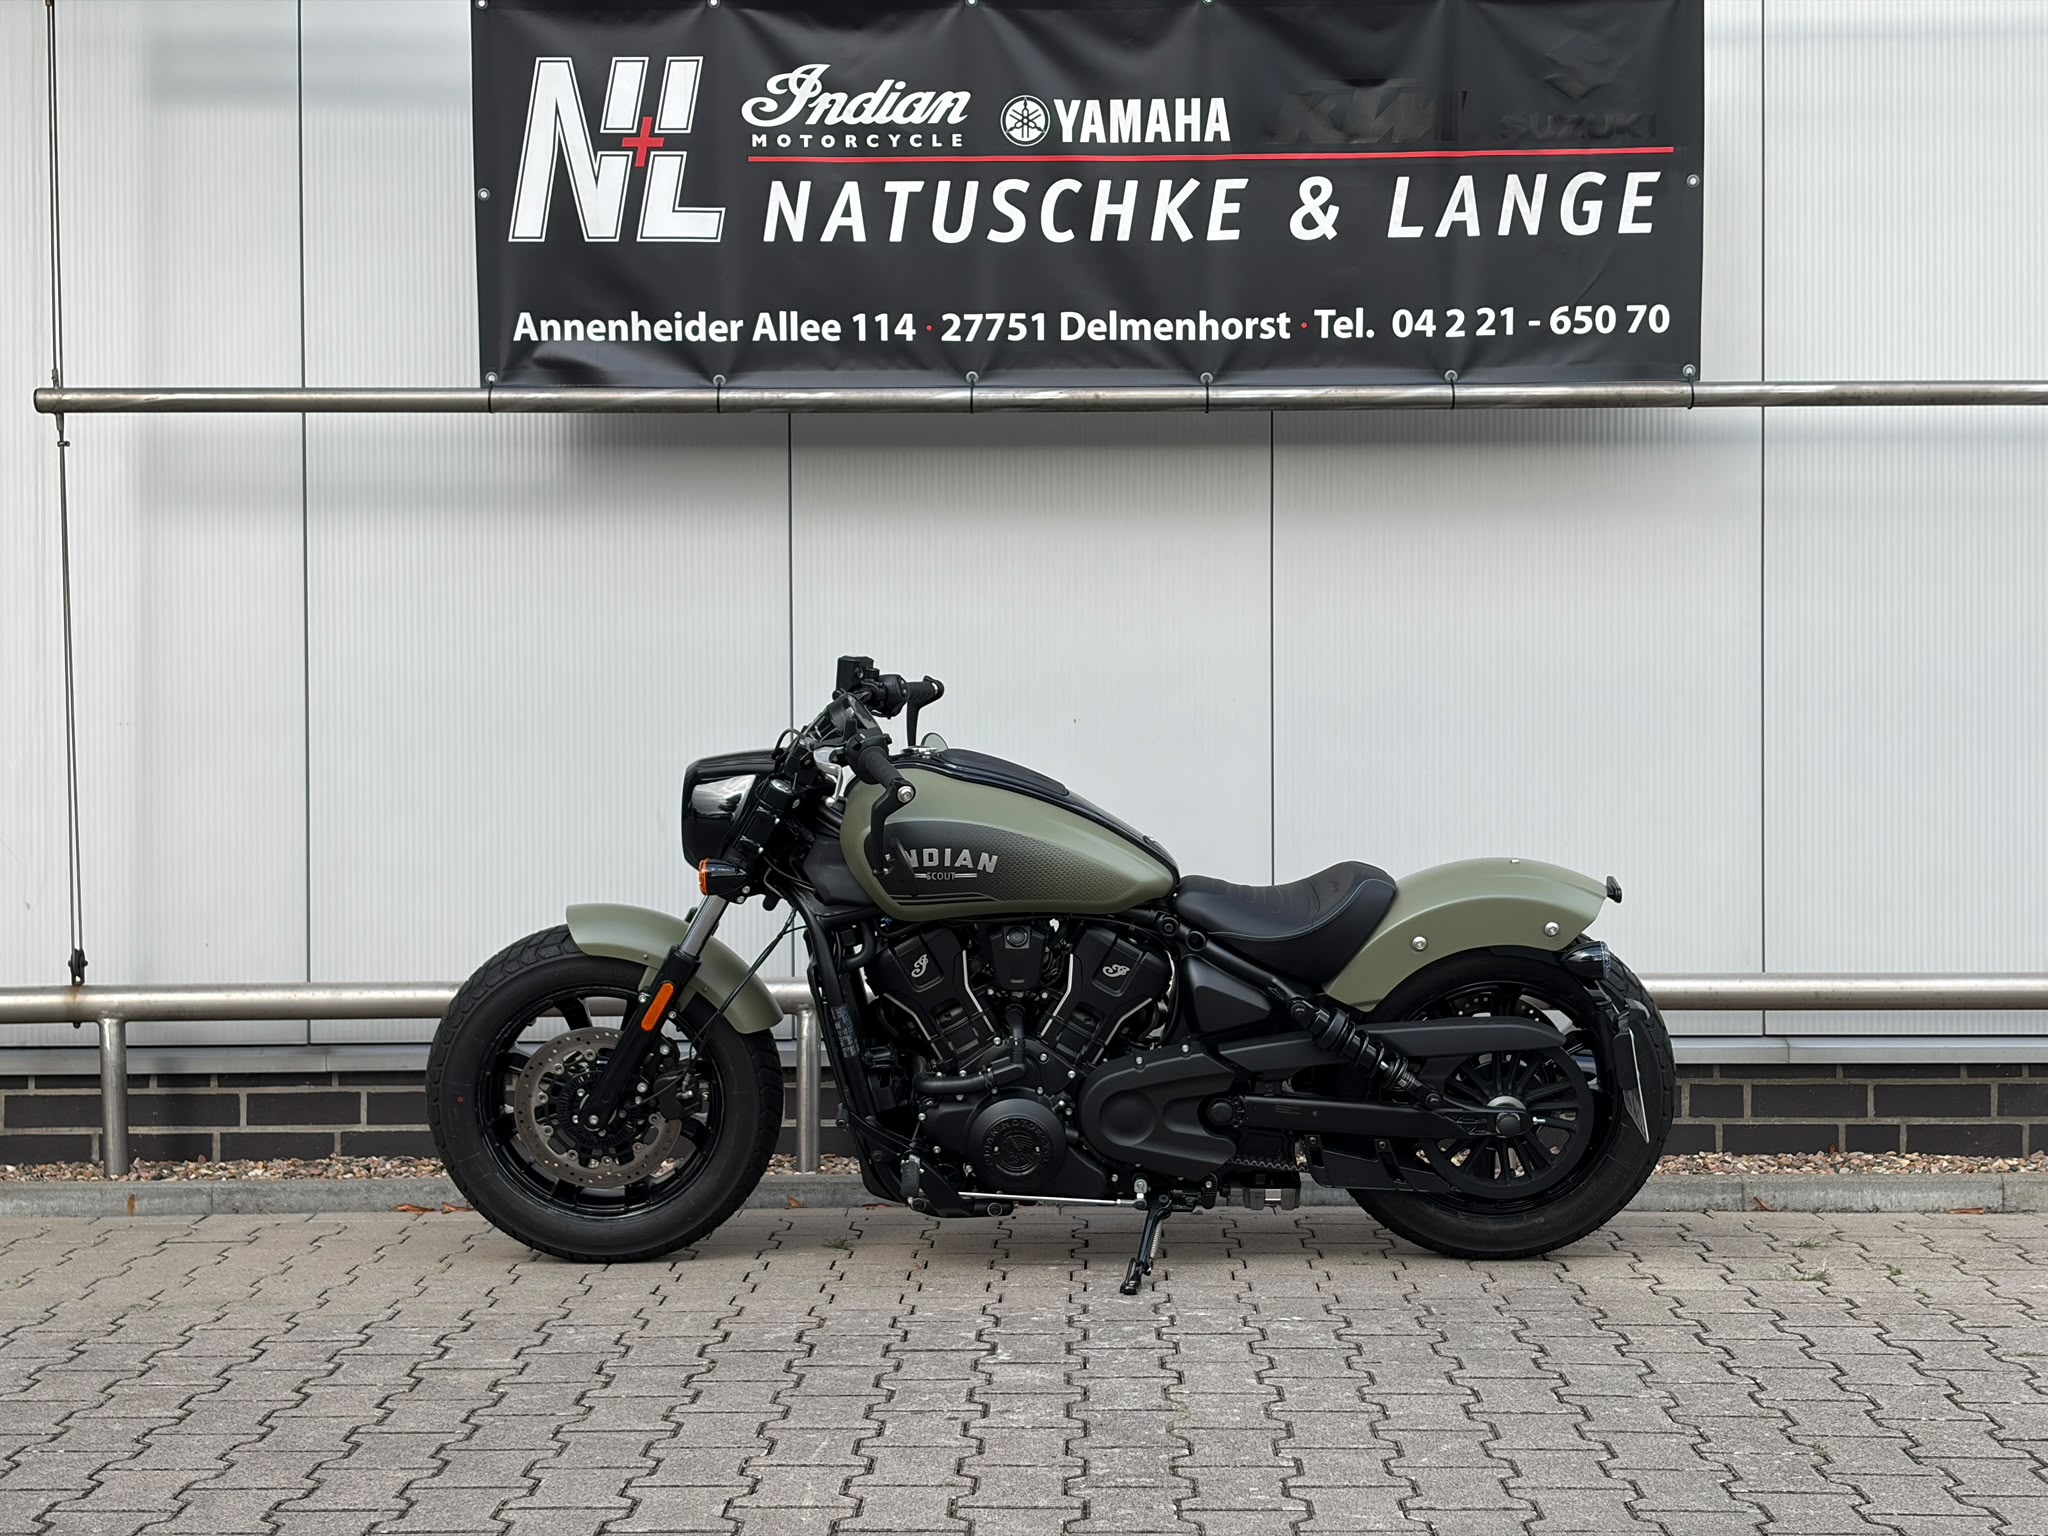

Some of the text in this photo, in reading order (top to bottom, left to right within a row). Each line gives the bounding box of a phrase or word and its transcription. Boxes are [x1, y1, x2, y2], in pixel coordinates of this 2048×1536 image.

[741, 63, 972, 127] Indian
[751, 133, 964, 149] MOTORCYCLE
[1053, 97, 1231, 144] YAMAHA
[764, 171, 1662, 244] NATUSCHKE & LANGE
[513, 310, 744, 343] Annenheider
[753, 310, 842, 342] Allee
[853, 313, 917, 342] 114
[942, 312, 1045, 342] 27751
[1060, 309, 1291, 341] Delmenhorst
[1314, 307, 1375, 339] Tel.
[926, 872, 956, 881] SCOUT
